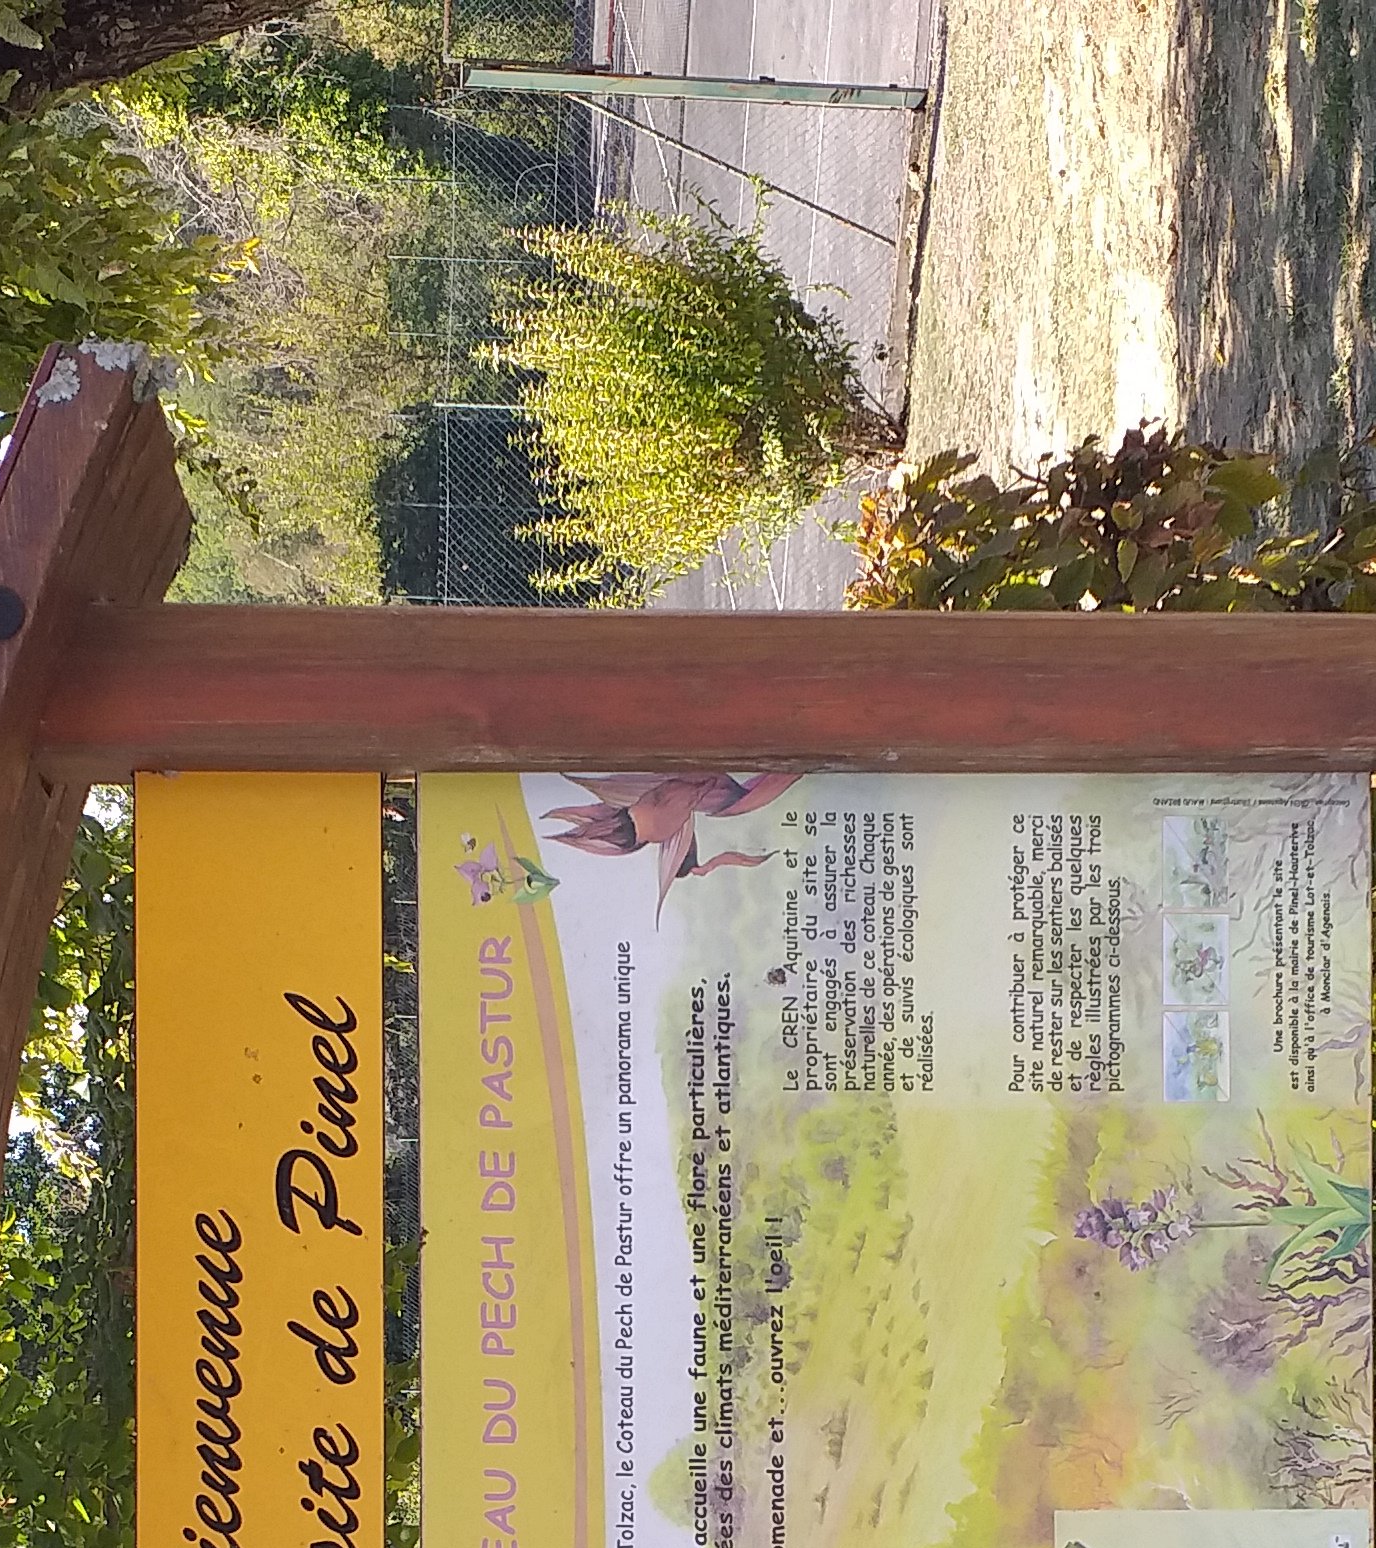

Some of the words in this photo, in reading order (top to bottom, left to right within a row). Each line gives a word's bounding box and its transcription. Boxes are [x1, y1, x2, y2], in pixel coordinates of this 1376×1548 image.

[781, 811, 797, 826] le
[805, 812, 817, 836] se
[820, 812, 836, 826] la
[859, 812, 880, 874] Chaque
[899, 813, 914, 851] sont
[783, 848, 798, 868] et
[840, 813, 857, 902] richesses
[878, 813, 898, 876] gestion
[1288, 822, 1300, 915] Pinel-Hauterive
[1305, 815, 1316, 905] Lot-et-Tolzac,
[802, 855, 817, 896] site
[824, 845, 837, 912] assurer
[878, 880, 894, 901] de
[1272, 887, 1283, 898] le
[1273, 859, 1283, 882] site
[783, 890, 802, 975] Aquitaine
[801, 915, 818, 941] du
[820, 929, 837, 939] à
[840, 920, 856, 954] des
[861, 882, 875, 943] coteau.
[897, 865, 918, 962] écologiques
[1272, 903, 1286, 967] présentant
[1288, 920, 1299, 934] de
[1305, 911, 1315, 961] tourisme
[1321, 890, 1334, 951] d'Agenais.
[614, 941, 635, 1004] unique
[863, 950, 875, 969] ce
[878, 906, 900, 997] opérations
[1288, 939, 1299, 975] mairie
[1304, 967, 1315, 981] de
[821, 958, 840, 1032] engagés
[859, 977, 876, 997] de
[899, 977, 914, 1023] suivis
[1272, 972, 1283, 1024] brochure
[1288, 981, 1299, 991] la
[1321, 956, 1331, 1003] Monclar
[479, 936, 513, 1128] PASTUR
[782, 997, 799, 1048] CREN
[801, 960, 822, 1091] propriétaire
[840, 971, 859, 1090] préservation
[878, 1001, 894, 1032] des
[1304, 986, 1315, 1031] l'office
[1320, 1007, 1331, 1015] à
[619, 1011, 637, 1105] panorama
[685, 978, 711, 1140] particulières,
[712, 972, 735, 1116] atlantiques.
[859, 1006, 876, 1091] naturelles
[898, 1038, 914, 1058] de
[917, 1011, 933, 1091] réalisées.
[1273, 1029, 1283, 1052] Une
[1288, 1009, 1303, 1066] disponible
[1304, 1035, 1318, 1061] qu'à
[783, 1070, 799, 1091] Le
[821, 1052, 837, 1092] sont
[880, 1037, 897, 1092] année,
[900, 1073, 914, 1091] et
[1290, 1070, 1299, 1090] est
[1304, 1065, 1315, 1092] ainsi
[273, 990, 361, 1236] Pinel
[619, 1112, 632, 1134] un
[713, 1125, 731, 1152] et
[479, 1151, 515, 1212] DE
[614, 1137, 633, 1196] offre
[688, 1152, 705, 1211] flore
[615, 1202, 632, 1266] Pastur
[692, 1223, 706, 1263] une
[713, 1163, 733, 1352] méditerranéens
[614, 1272, 632, 1296] de
[689, 1275, 706, 1301] et
[765, 1234, 784, 1293] l'oeil
[480, 1236, 516, 1356] PECH
[284, 1287, 361, 1385] de
[615, 1304, 633, 1349] Pech
[688, 1313, 708, 1380] faune
[615, 1356, 633, 1379] du
[767, 1305, 785, 1443] et...ouvrez
[483, 1379, 518, 1444] DU
[616, 1386, 633, 1453] Coteau
[692, 1391, 707, 1431] une
[714, 1363, 733, 1449] climats
[616, 1459, 633, 1476] le
[716, 1460, 733, 1501] des
[689, 1443, 708, 1546] accueille
